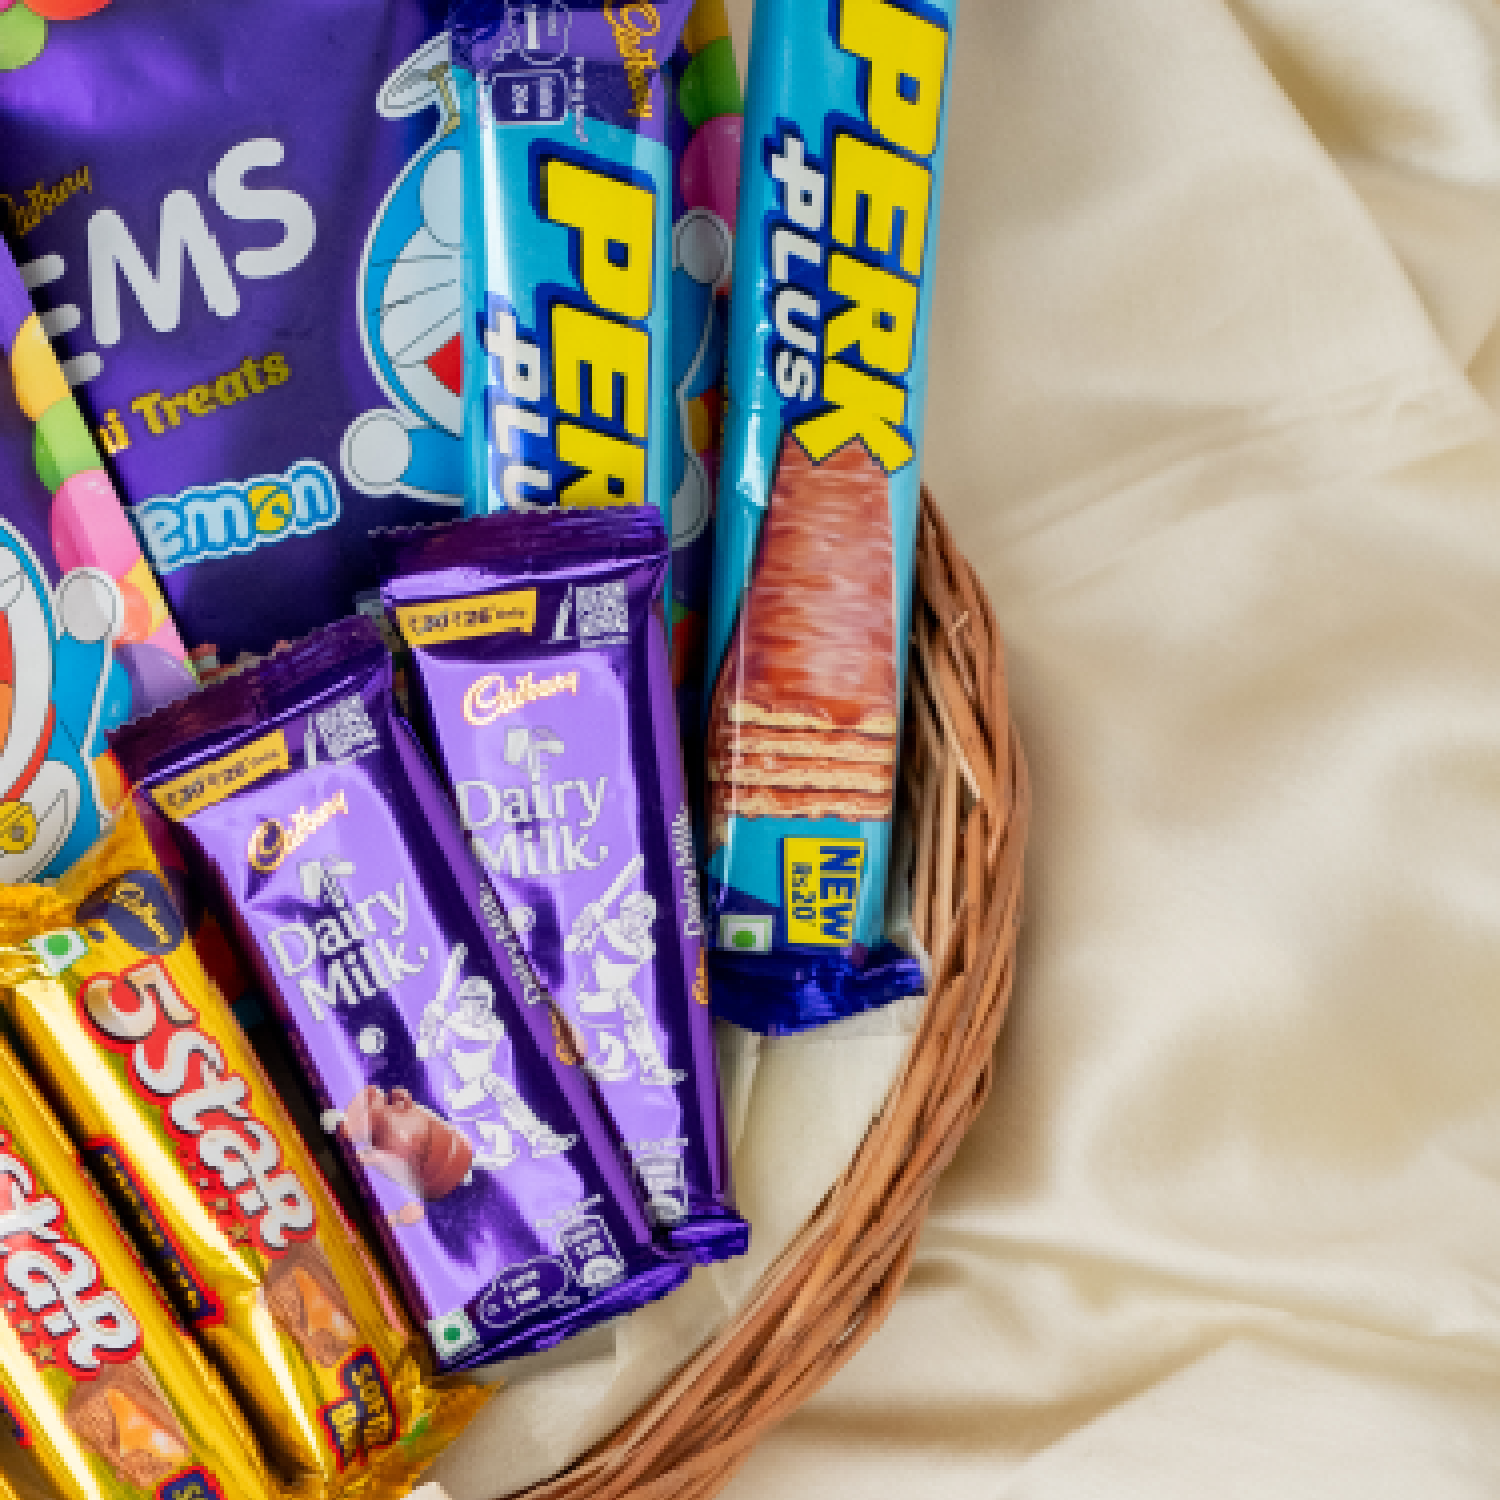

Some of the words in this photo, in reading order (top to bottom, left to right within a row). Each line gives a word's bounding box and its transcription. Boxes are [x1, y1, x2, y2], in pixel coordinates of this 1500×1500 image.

[19, 137, 316, 387] EMS
[771, 135, 826, 399] PLUS
[792, 0, 950, 475] PERK
[547, 157, 656, 506] PER
[132, 352, 291, 435] Treats
[484, 311, 553, 509] PLU
[137, 462, 340, 570] emon
[462, 670, 580, 725] Cadbury
[247, 792, 349, 873] Cadbury
[456, 777, 608, 840] Dairy
[473, 825, 612, 878] Milk
[268, 878, 410, 975] Dairy
[819, 845, 861, 940] NEW
[298, 939, 430, 1023] Milk
